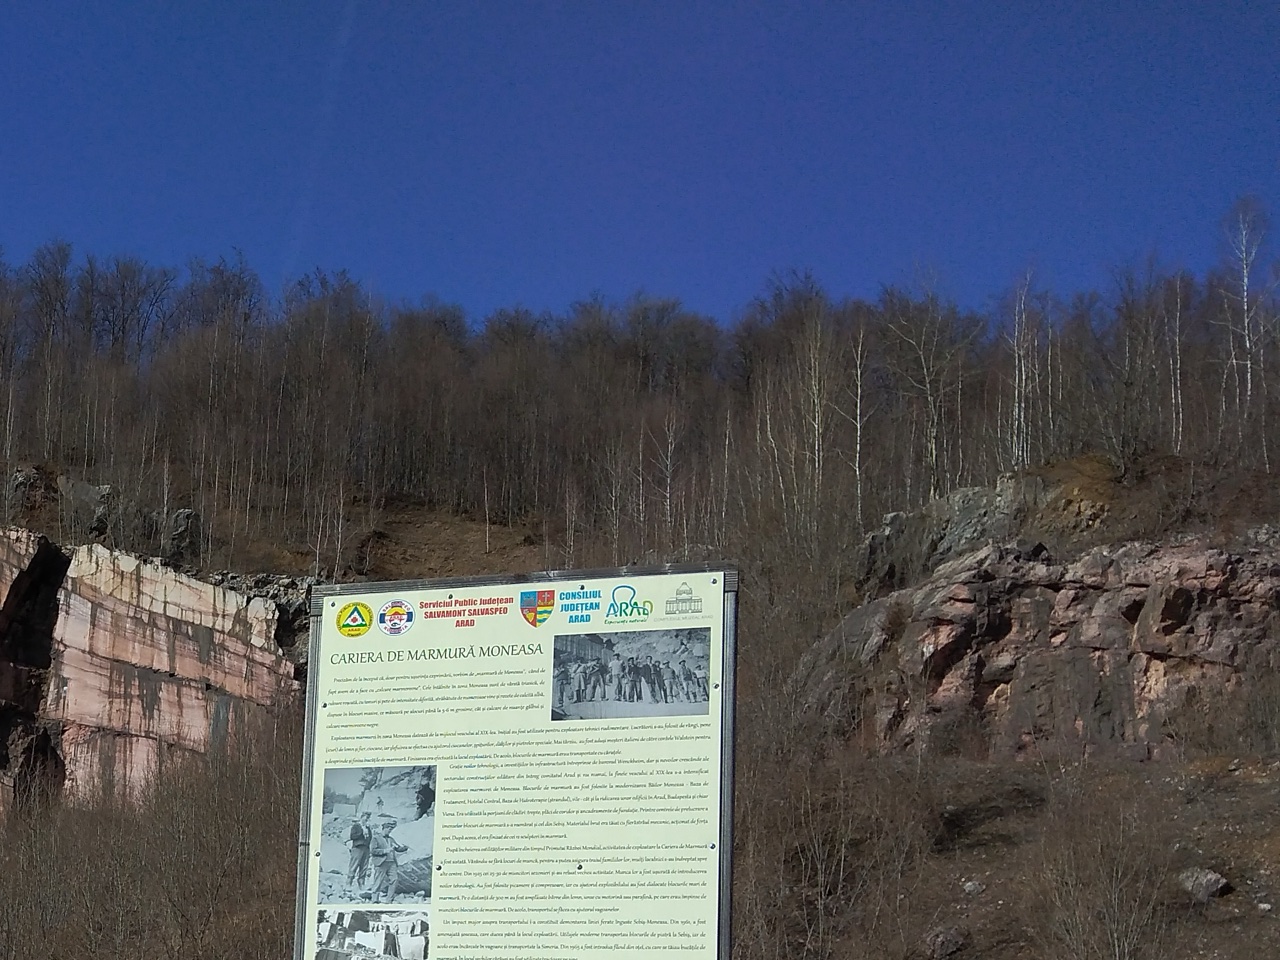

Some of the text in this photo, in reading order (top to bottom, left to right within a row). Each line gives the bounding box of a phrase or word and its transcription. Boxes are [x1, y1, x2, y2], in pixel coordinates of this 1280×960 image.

[559, 590, 602, 600] CONSILIUL
[419, 599, 452, 608] Serviciul
[454, 598, 477, 606] Public
[560, 602, 599, 613] JUDEȚEAN
[424, 606, 507, 619] SALVAMONT SALVASPEO
[606, 600, 653, 618] ARAD
[455, 619, 474, 627] ARAD
[568, 614, 590, 623] ARAD
[330, 643, 543, 664] CARIERA DE MARMURĂ MONEASA
